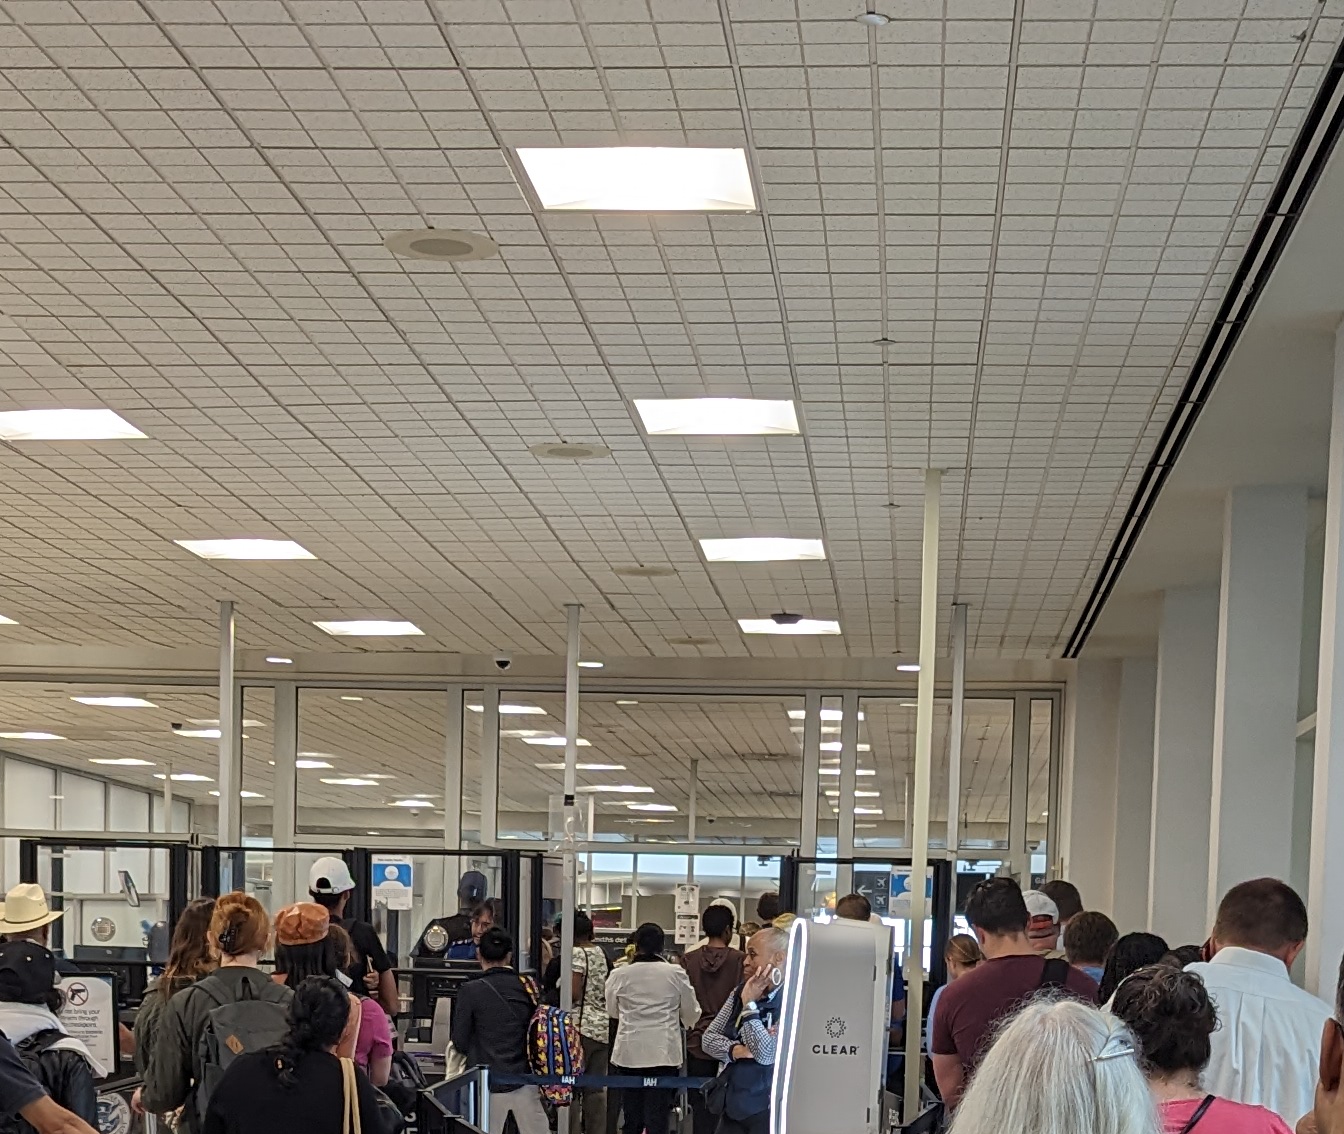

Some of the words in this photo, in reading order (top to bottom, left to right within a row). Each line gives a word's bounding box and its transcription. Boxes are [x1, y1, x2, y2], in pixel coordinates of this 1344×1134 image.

[812, 1044, 857, 1056] CLEAR
[561, 1076, 575, 1084] IAH
[643, 1077, 657, 1087] IAH
